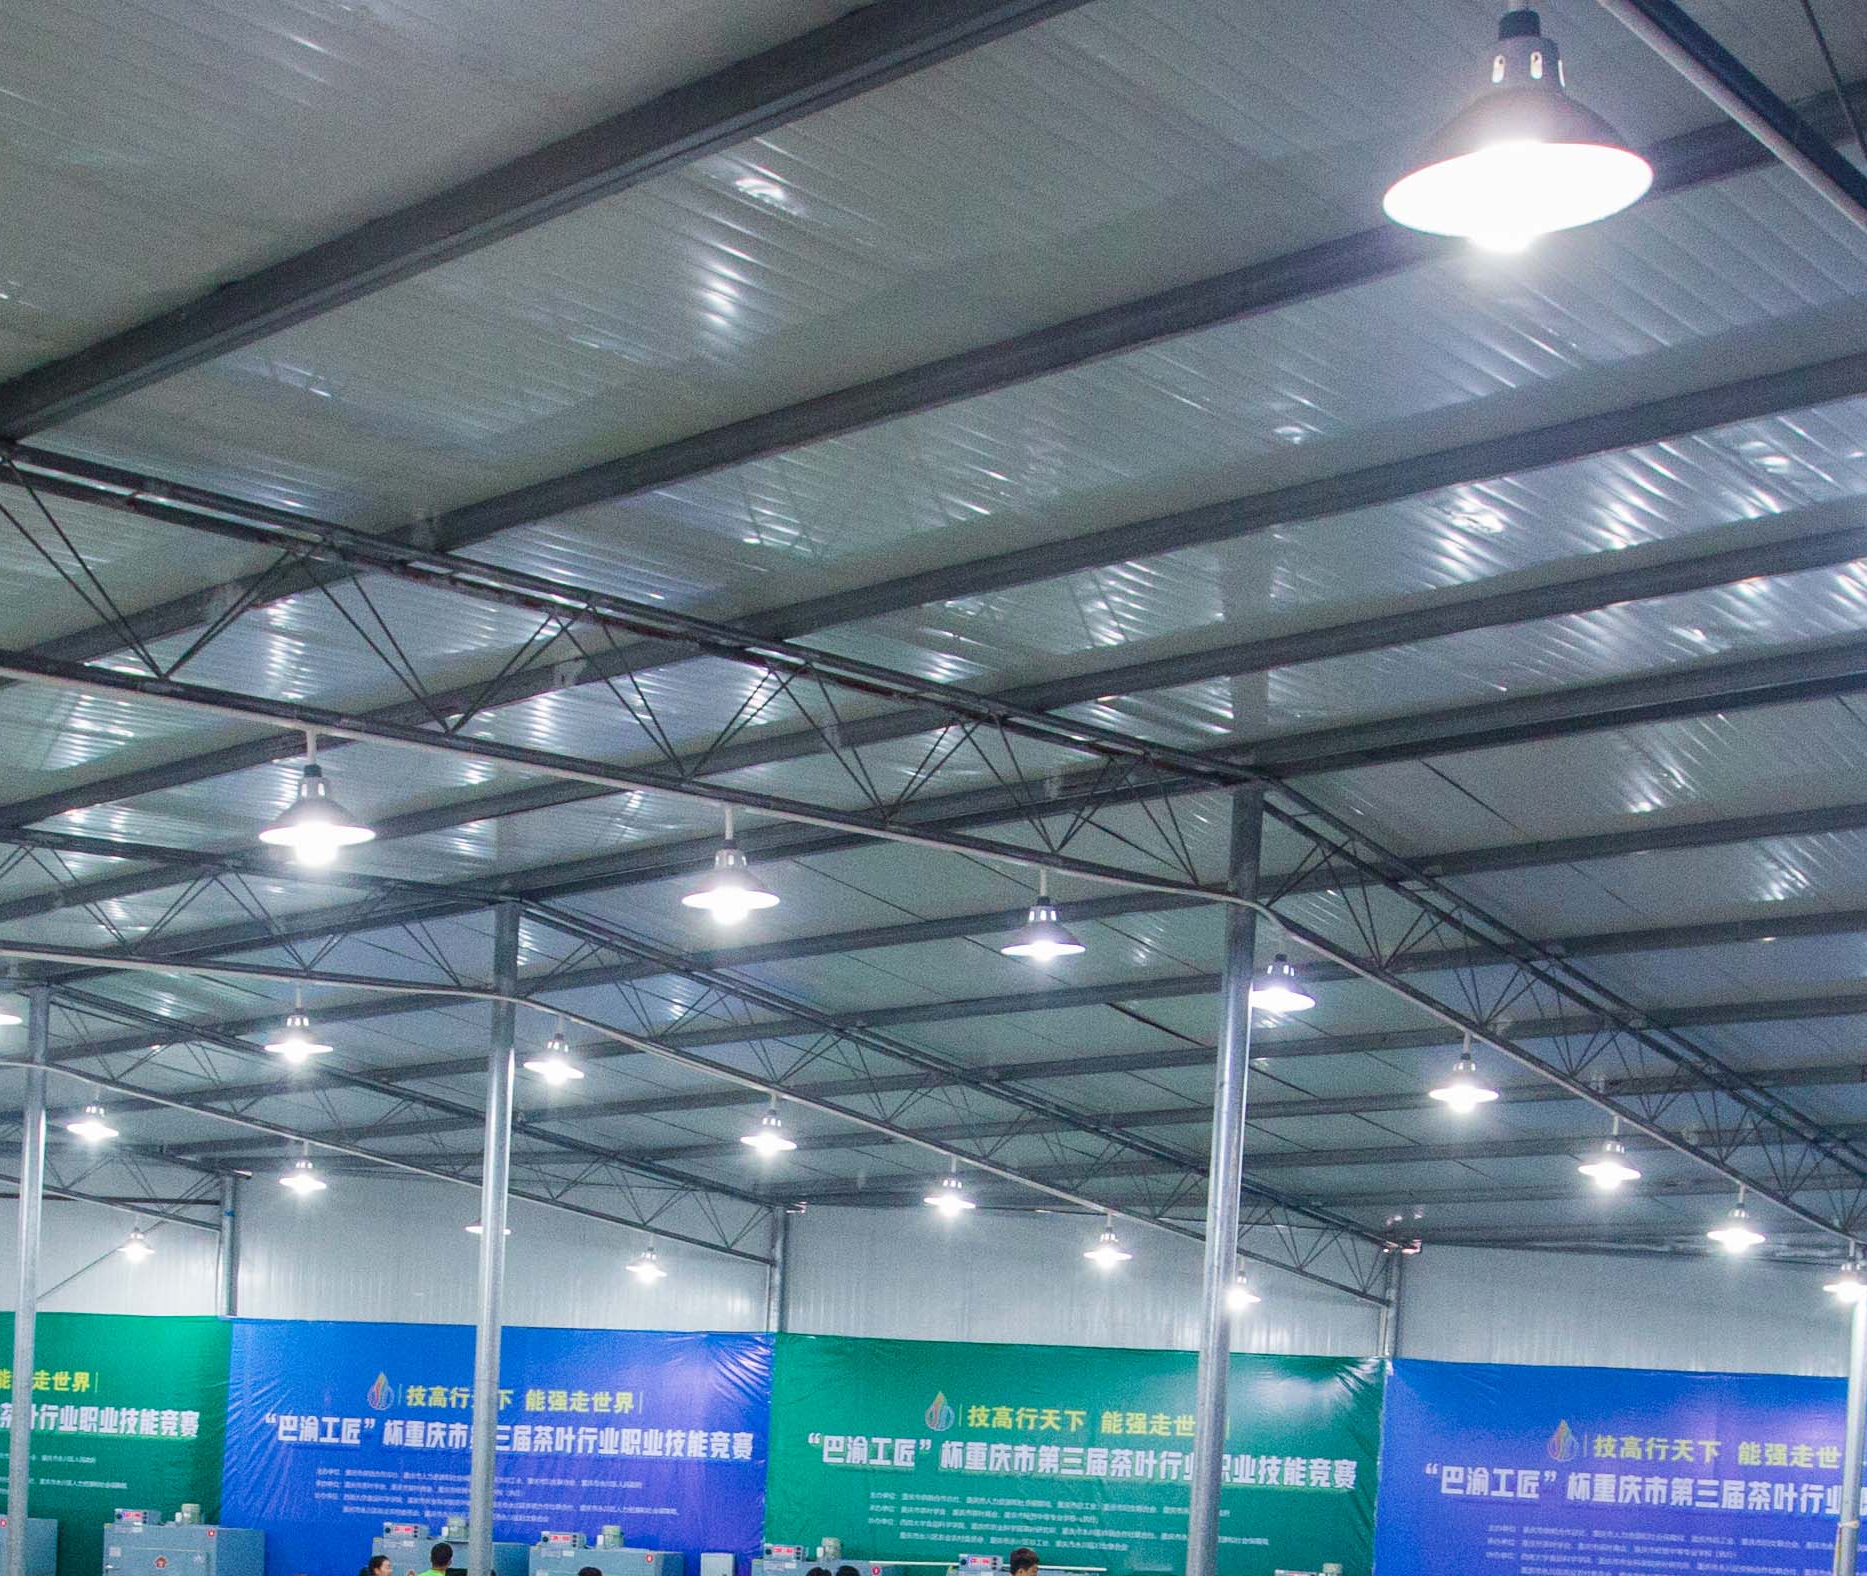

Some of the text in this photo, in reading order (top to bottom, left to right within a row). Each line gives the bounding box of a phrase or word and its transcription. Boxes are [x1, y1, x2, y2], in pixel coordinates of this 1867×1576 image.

[406, 1384, 635, 1415] 技高行下 能强走世界
[265, 1411, 754, 1461] “巴渝工匠”杯重庆市三届茶叶行业职业技能竞赛
[967, 1405, 1196, 1437] 技高行天下 能强走世
[1593, 1434, 1843, 1469] 技高行天下 能强走世
